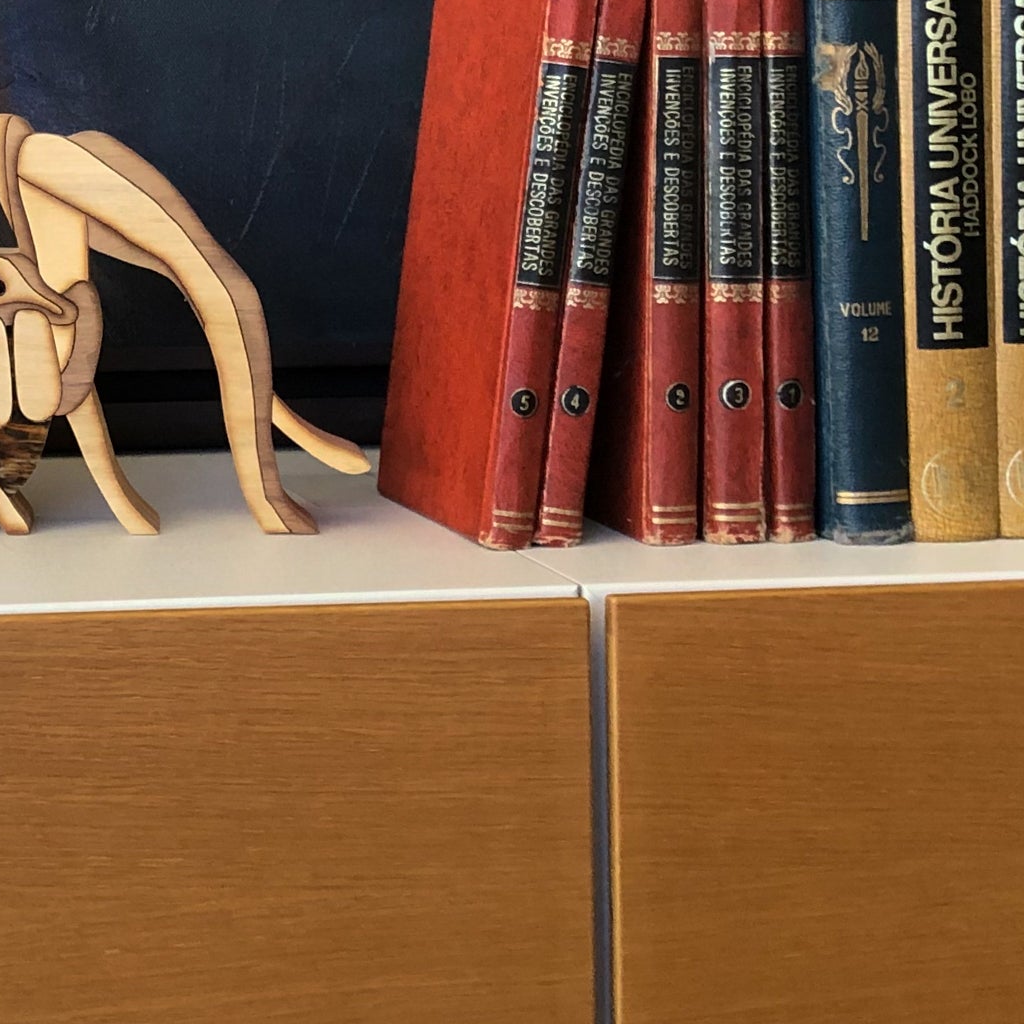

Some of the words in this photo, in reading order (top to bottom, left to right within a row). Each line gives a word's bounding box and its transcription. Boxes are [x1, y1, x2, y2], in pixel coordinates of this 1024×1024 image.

[536, 74, 561, 152] INVENÇÕES
[591, 73, 616, 151] INVENÇÕES
[663, 69, 681, 146] INVENÇÕES
[717, 68, 735, 145] INVENÇÕES
[737, 66, 755, 163] ENCICLOPÉDIA
[769, 68, 786, 146] INVENÇÕES
[534, 157, 550, 166] E
[589, 156, 606, 165] E
[663, 152, 680, 161] E
[719, 152, 735, 160] E
[770, 152, 785, 160] E
[547, 176, 565, 205] DAS
[603, 176, 620, 204] DAS
[680, 170, 694, 197] DAS
[737, 169, 752, 196] DAS
[786, 169, 799, 196] DAS
[962, 133, 980, 237] HADDOCK
[522, 172, 548, 271] DESCOBERTAS
[576, 171, 604, 270] DESCOBERTAS
[662, 167, 679, 266] DESCOBERTAS
[679, 203, 693, 270] GRANDES
[719, 166, 736, 265] DESCOBERTAS
[737, 202, 752, 268] GRANDES
[770, 167, 787, 265] DESCOBERTAS
[786, 202, 801, 268] GRANDES
[538, 211, 560, 276] GRANDES
[593, 211, 616, 275] GRANDES
[923, 176, 964, 340] HISTÓRIA
[840, 301, 892, 317] VOLUME
[861, 327, 879, 342] 12
[519, 395, 529, 410] 5
[569, 393, 579, 409] 4
[676, 389, 685, 404] 2
[734, 387, 743, 402] 3
[788, 388, 796, 402] 1
[945, 377, 966, 410] 2
